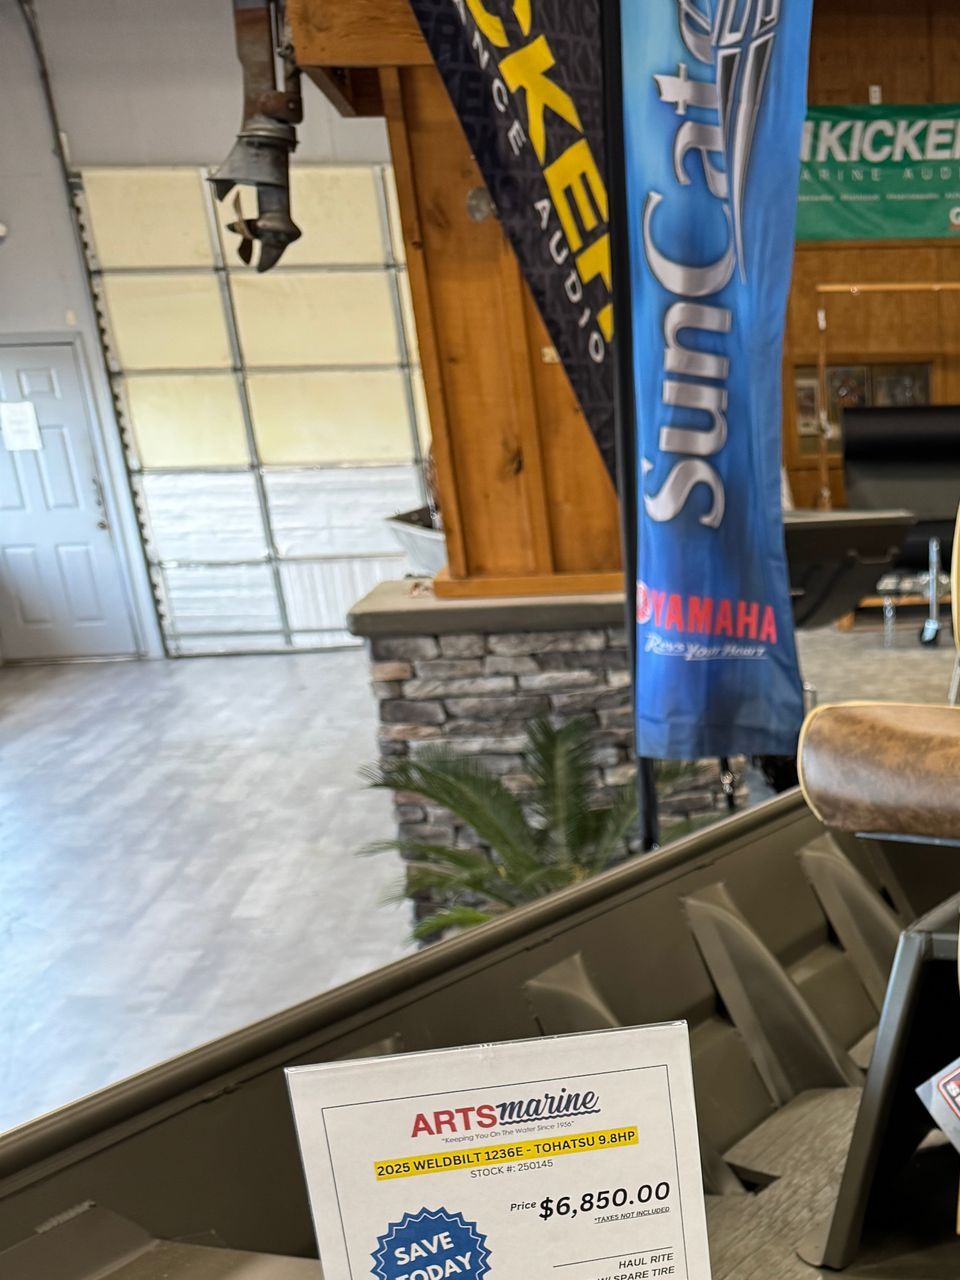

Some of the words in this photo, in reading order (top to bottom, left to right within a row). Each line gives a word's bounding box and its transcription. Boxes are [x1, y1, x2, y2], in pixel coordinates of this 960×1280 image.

[800, 168, 881, 182] ARINE
[534, 199, 605, 363] AUDIO
[651, 588, 777, 645] YAMAHA
[475, 1132, 489, 1141] You
[490, 1130, 500, 1138] On
[502, 1128, 514, 1137] The
[515, 1126, 536, 1135] Water
[537, 1123, 555, 1132] Since
[377, 1162, 411, 1176] 2025
[413, 1153, 482, 1171] WELDBILT
[485, 1147, 524, 1161] 1236E
[534, 1137, 596, 1155] TOHATSU
[598, 1131, 636, 1145] 9.8HP
[470, 1166, 504, 1178] STOCK
[506, 1164, 516, 1173] #:
[518, 1159, 554, 1172] 250145
[510, 1200, 537, 1212] Price
[539, 1181, 670, 1221] $6,850.00
[621, 1210, 636, 1219] NOT
[636, 1206, 670, 1218] INCLUDED
[394, 1231, 455, 1266] SAVE
[618, 1257, 648, 1270] HAUL
[650, 1252, 674, 1265] RITE
[651, 1265, 675, 1278] TIRE
